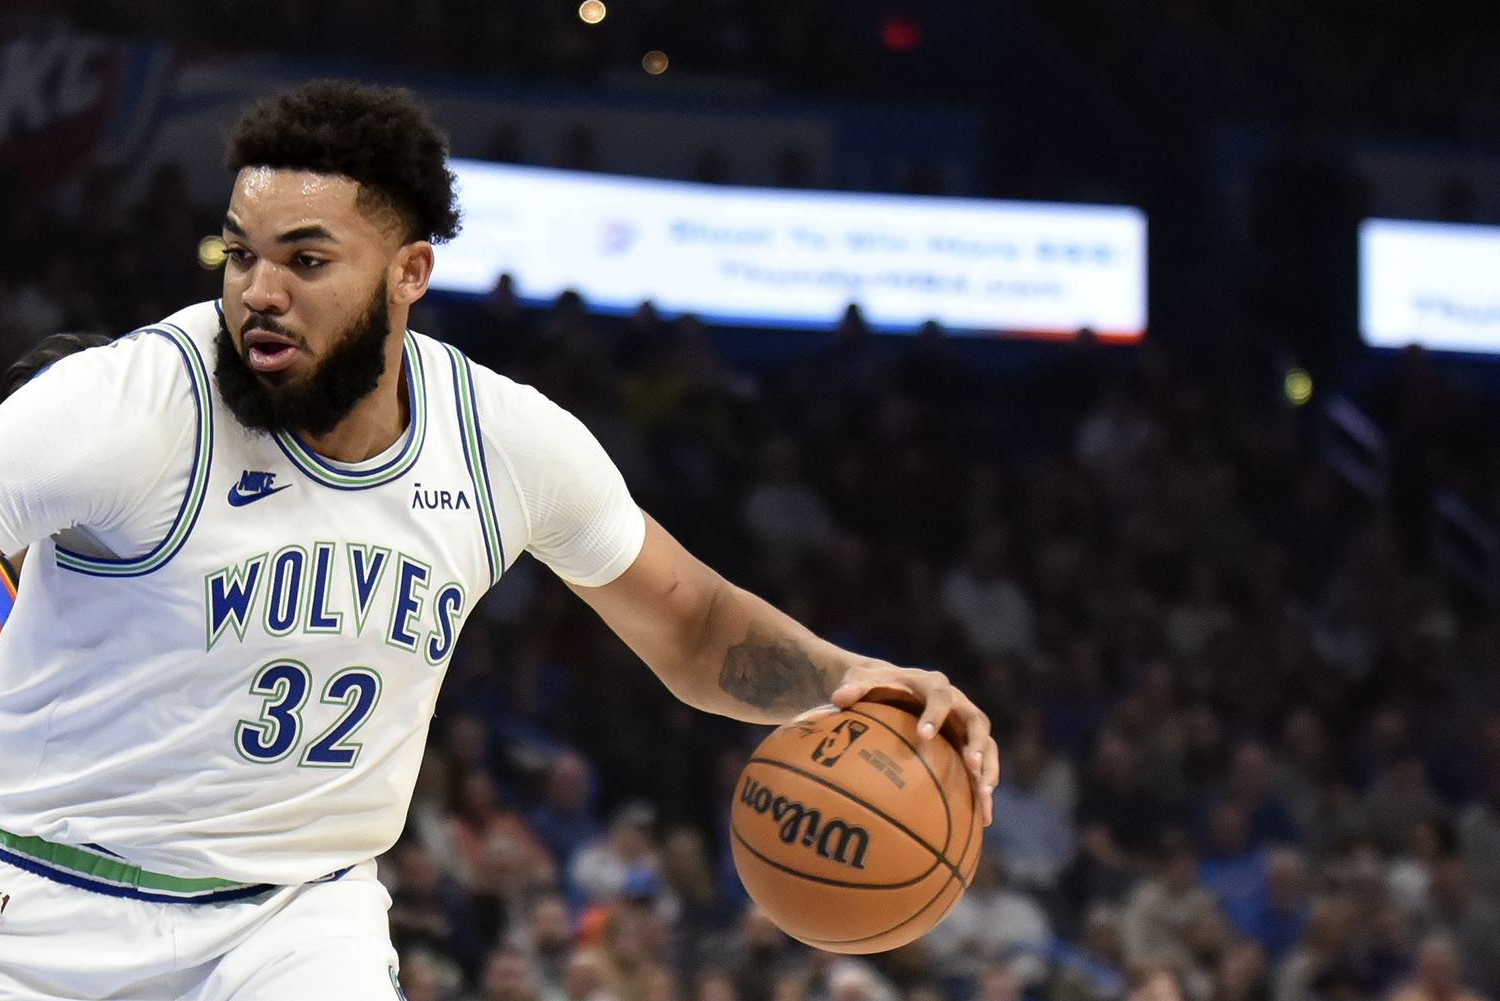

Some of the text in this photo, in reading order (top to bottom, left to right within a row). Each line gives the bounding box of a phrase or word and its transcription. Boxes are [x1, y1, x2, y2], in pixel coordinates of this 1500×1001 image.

[238, 469, 276, 493] NIKE
[204, 540, 467, 667] WOLVES
[233, 658, 383, 769] 32
[739, 776, 870, 870] Wilson
